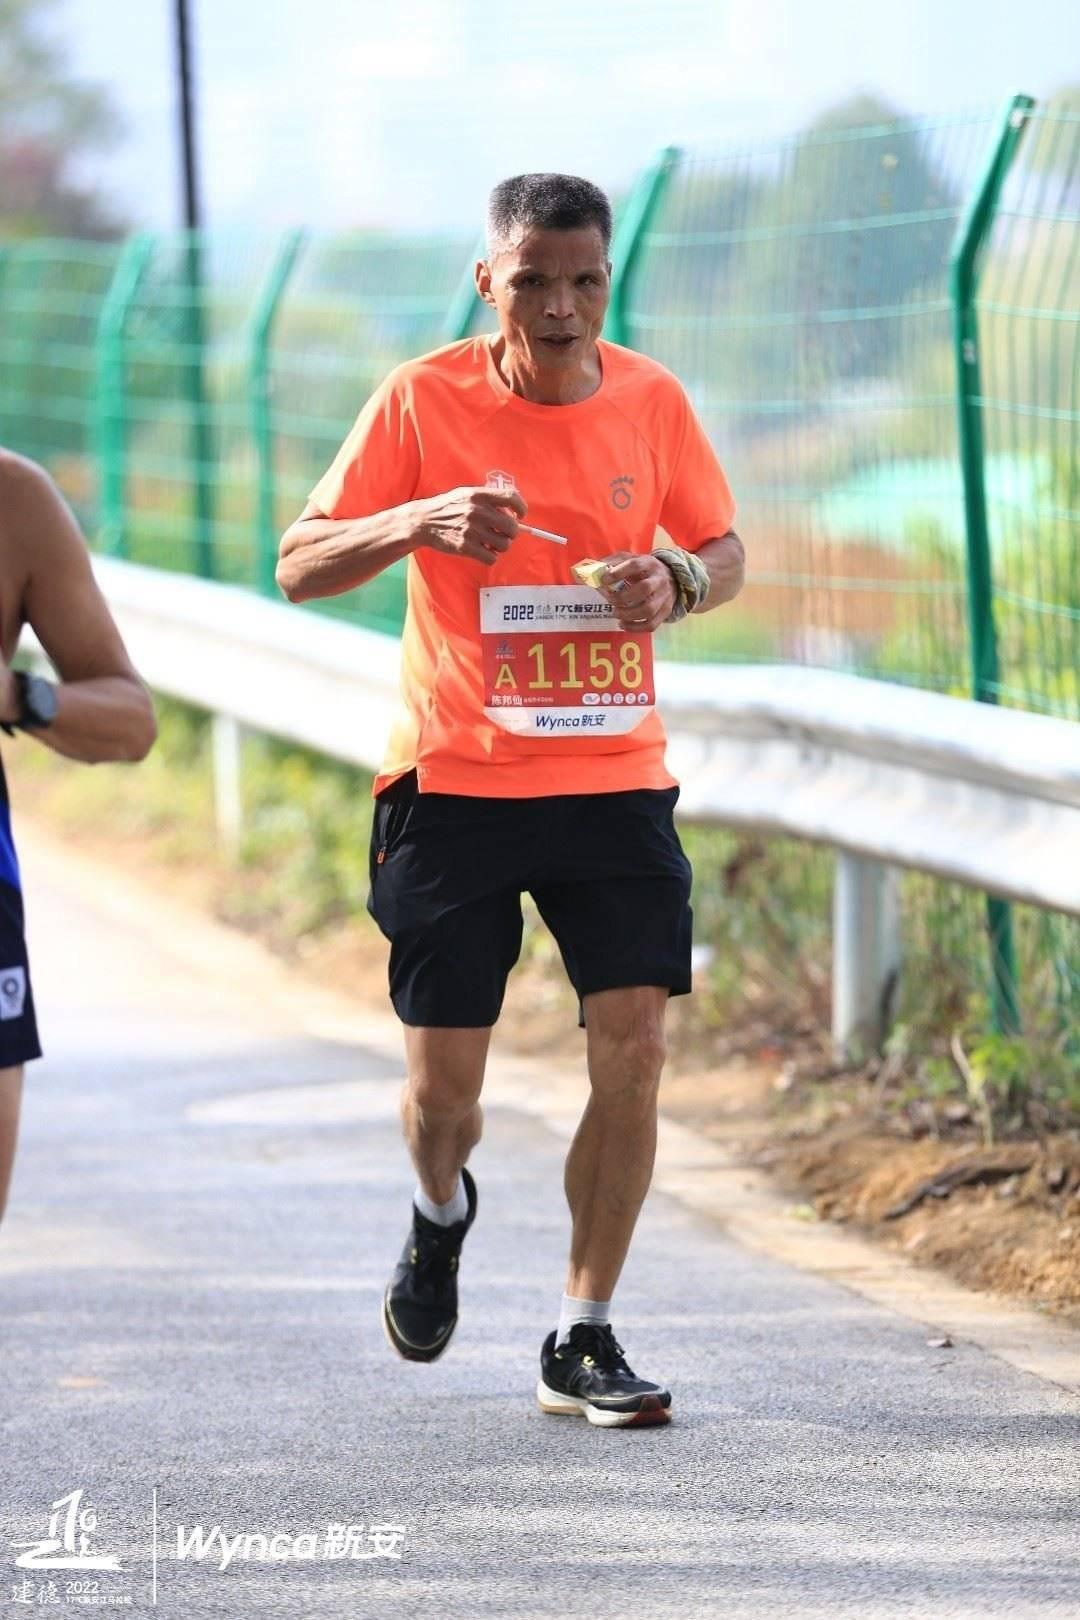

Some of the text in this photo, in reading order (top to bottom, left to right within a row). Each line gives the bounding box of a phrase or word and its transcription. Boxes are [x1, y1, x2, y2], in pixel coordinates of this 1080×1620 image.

[503, 604, 534, 620] 2022
[494, 642, 643, 689] A 1158
